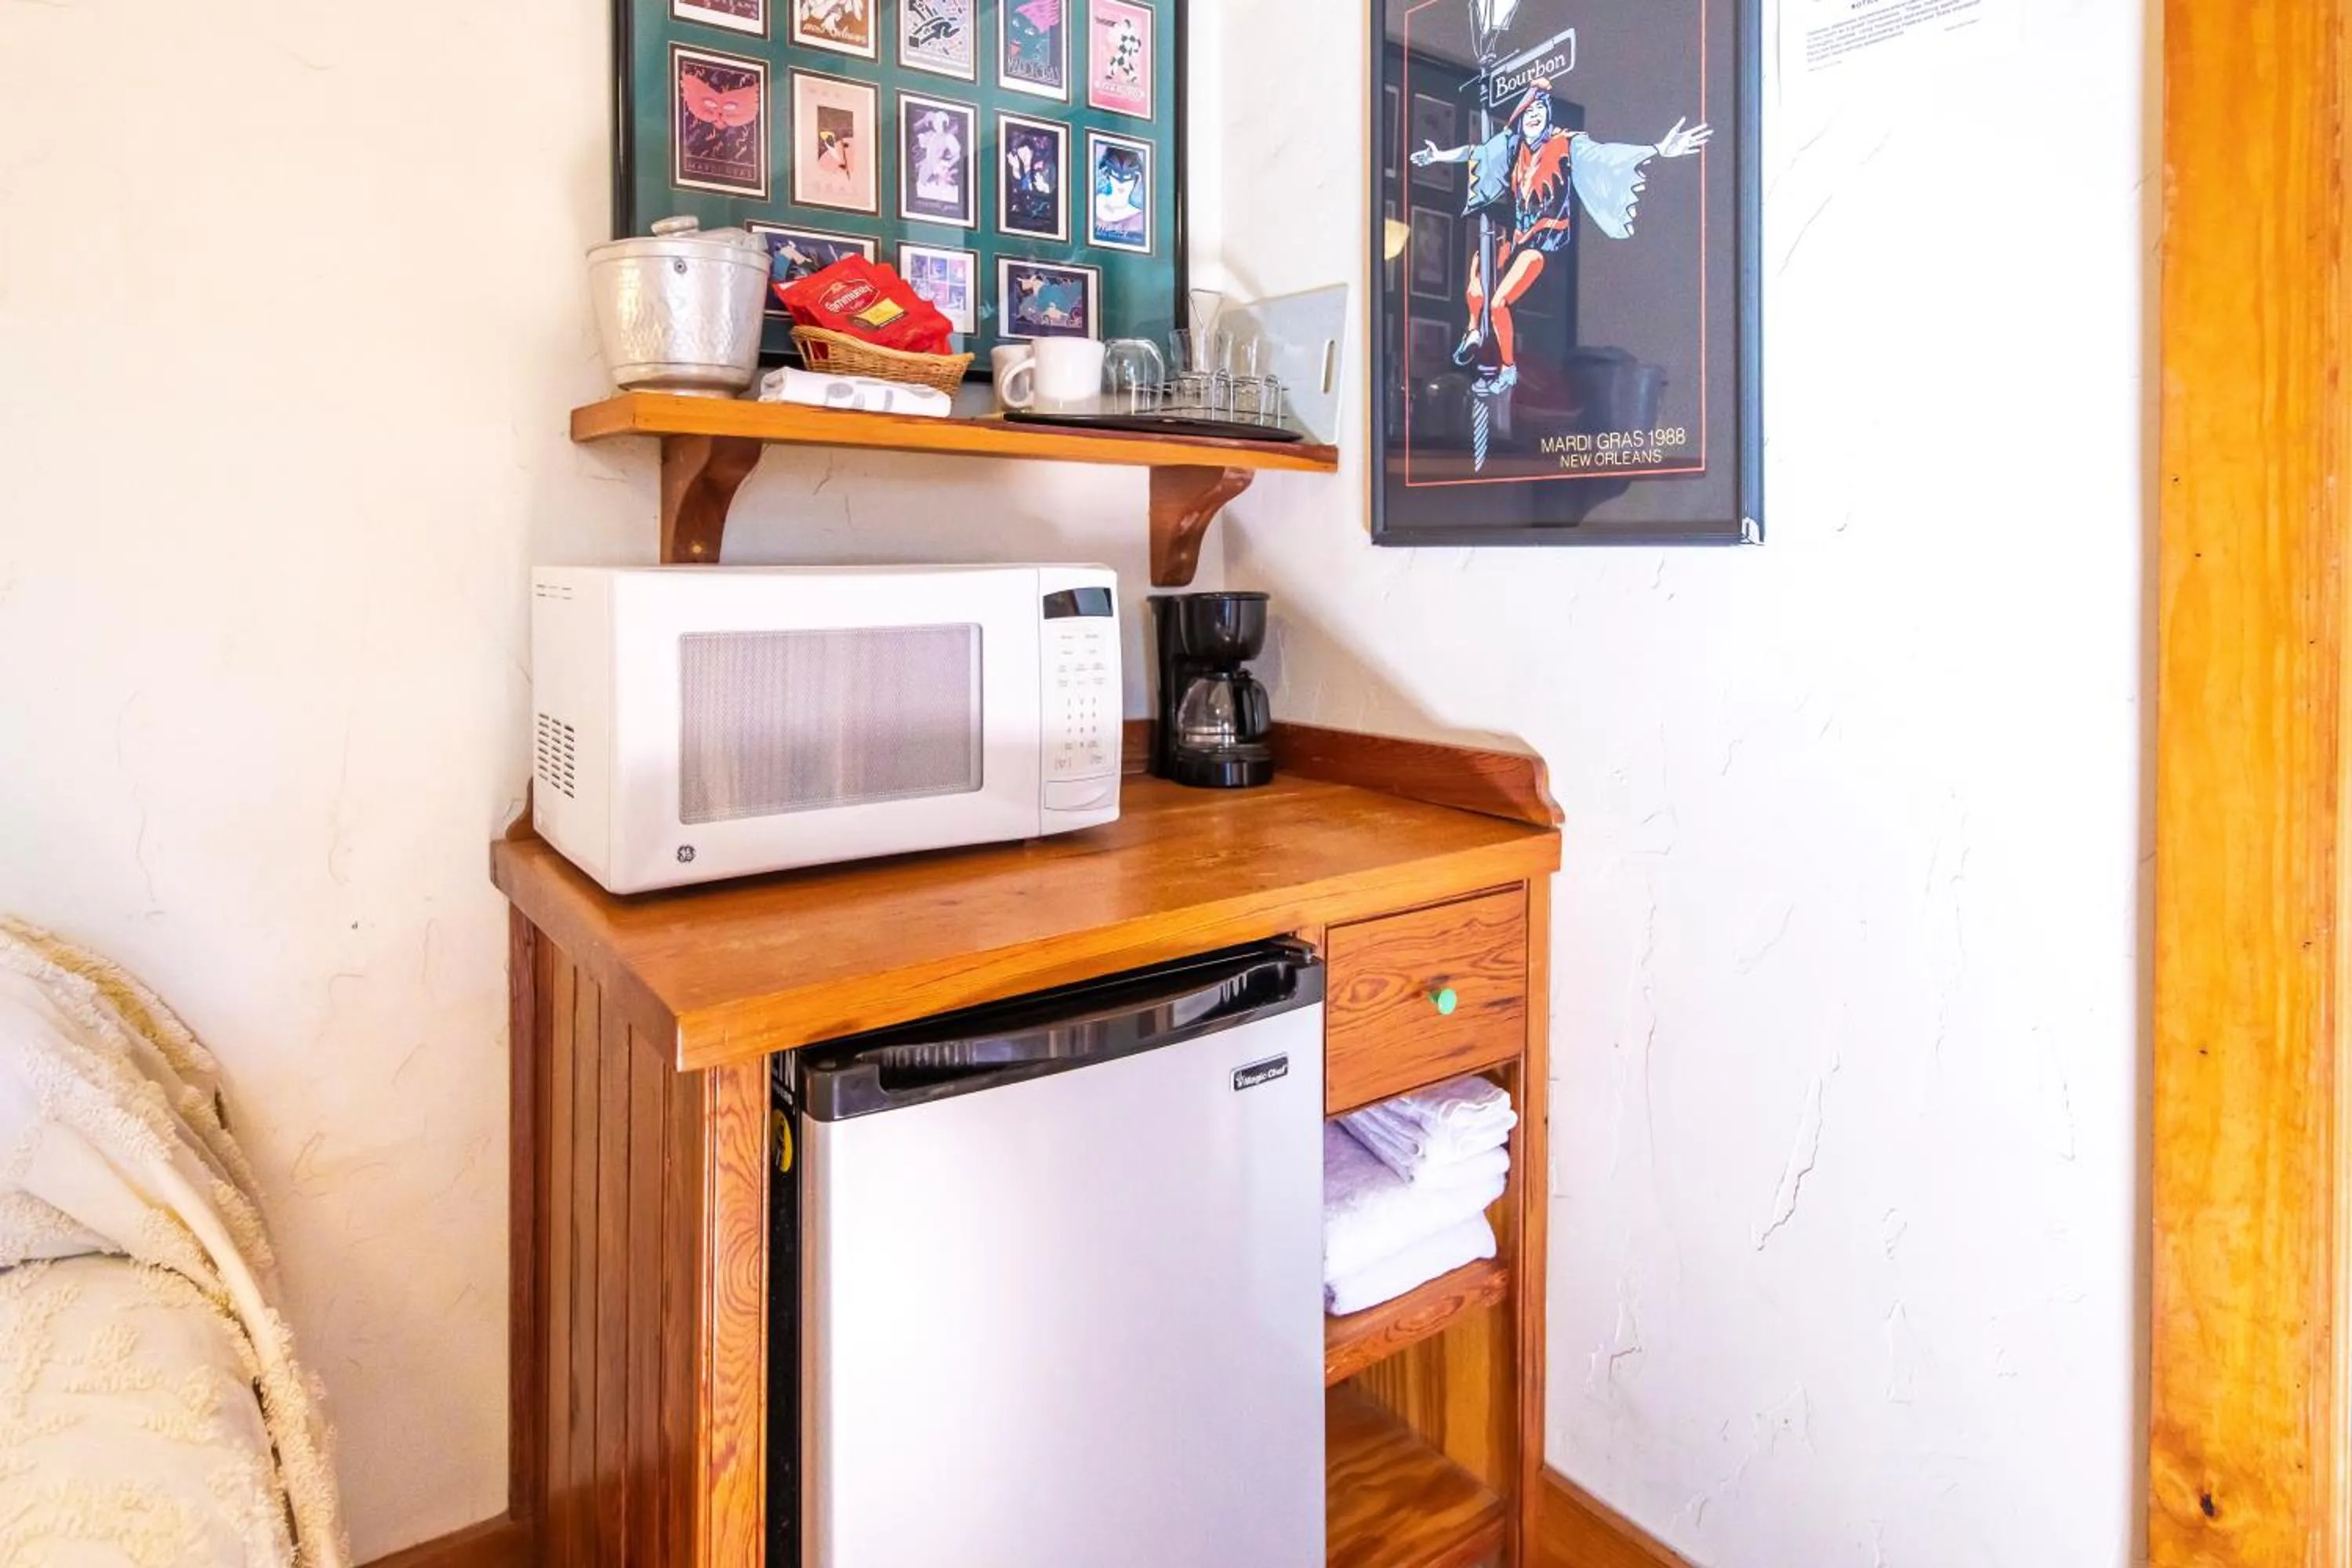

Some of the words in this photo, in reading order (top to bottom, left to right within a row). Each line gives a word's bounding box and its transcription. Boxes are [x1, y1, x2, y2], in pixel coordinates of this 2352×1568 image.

[1495, 54, 1566, 98] Bourbon
[1541, 435, 1592, 452] MARDI
[1596, 430, 1645, 450] GRAS
[1648, 427, 1686, 446] 1988
[1560, 454, 1593, 468] NEW
[1594, 448, 1663, 466] ORLEANS
[1244, 1073, 1267, 1085] Magic
[1268, 1065, 1286, 1078] Chef
